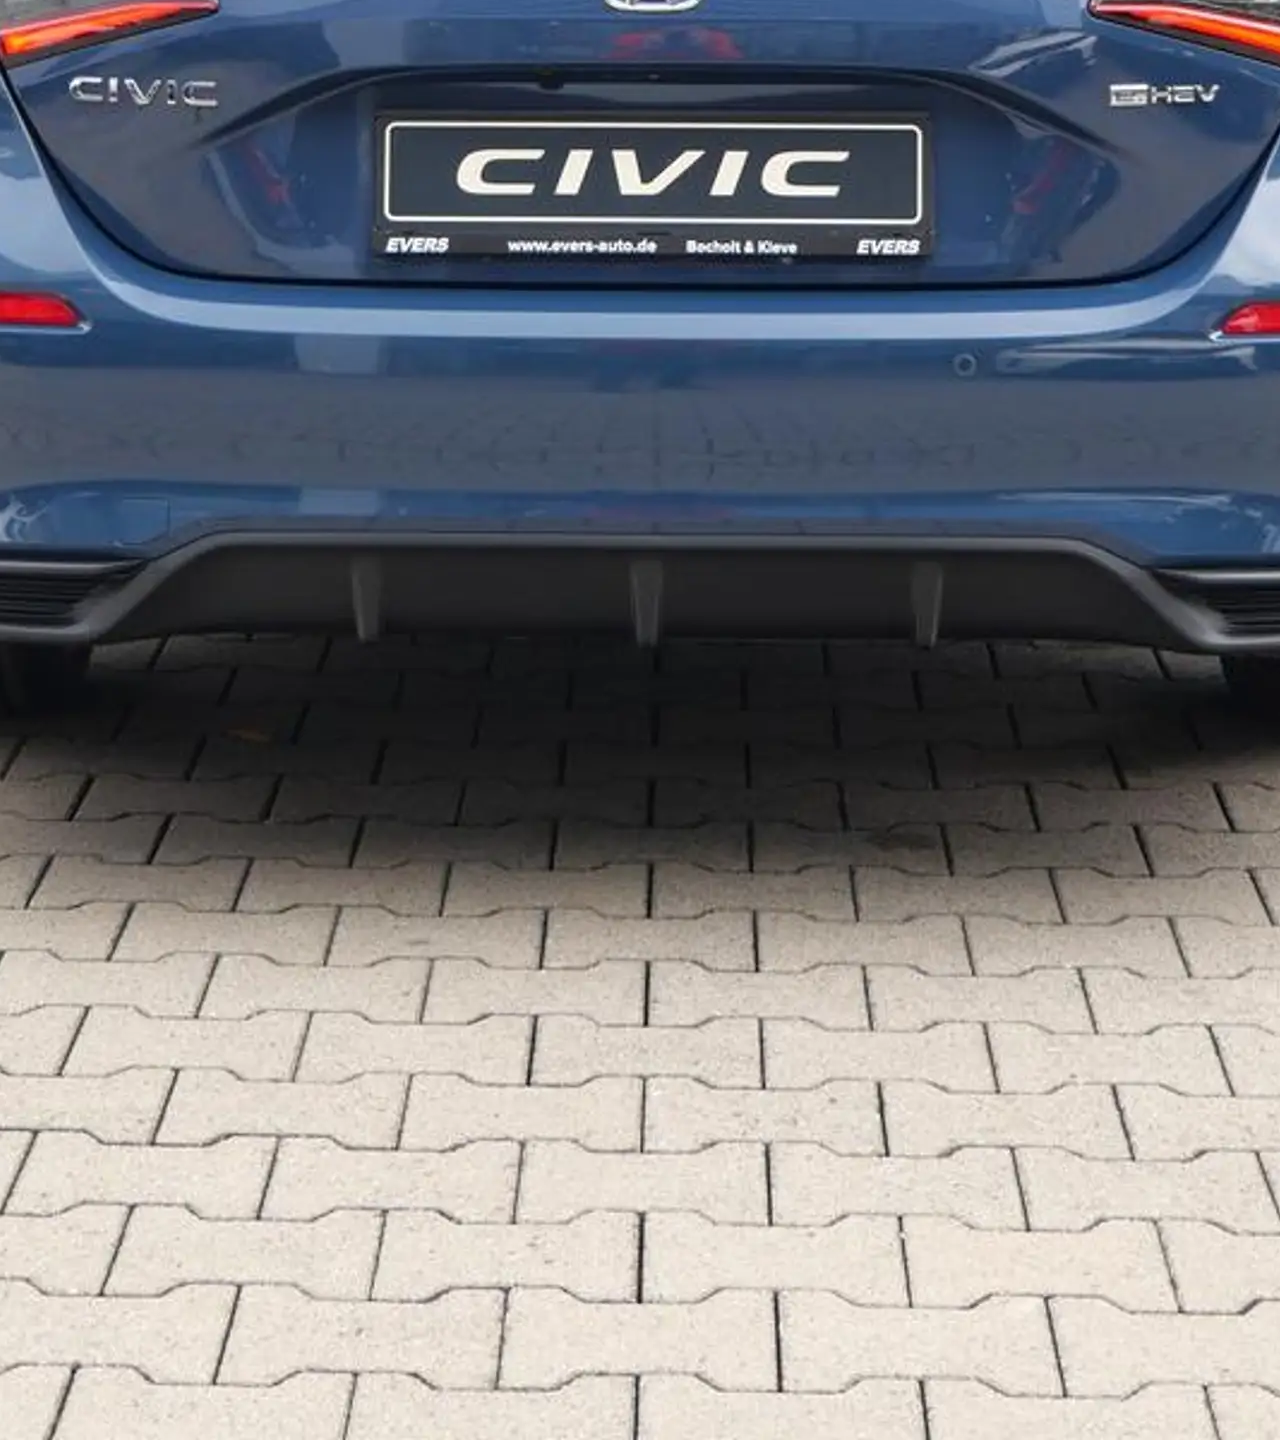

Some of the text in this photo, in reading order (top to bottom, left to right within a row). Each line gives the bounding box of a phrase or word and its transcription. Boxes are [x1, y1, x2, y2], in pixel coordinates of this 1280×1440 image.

[68, 76, 218, 106] CIVIC
[456, 148, 850, 197] CIVIC
[385, 236, 450, 253] EVERS
[506, 239, 658, 253] www.evers-auto.de
[856, 239, 921, 255] EVERS
